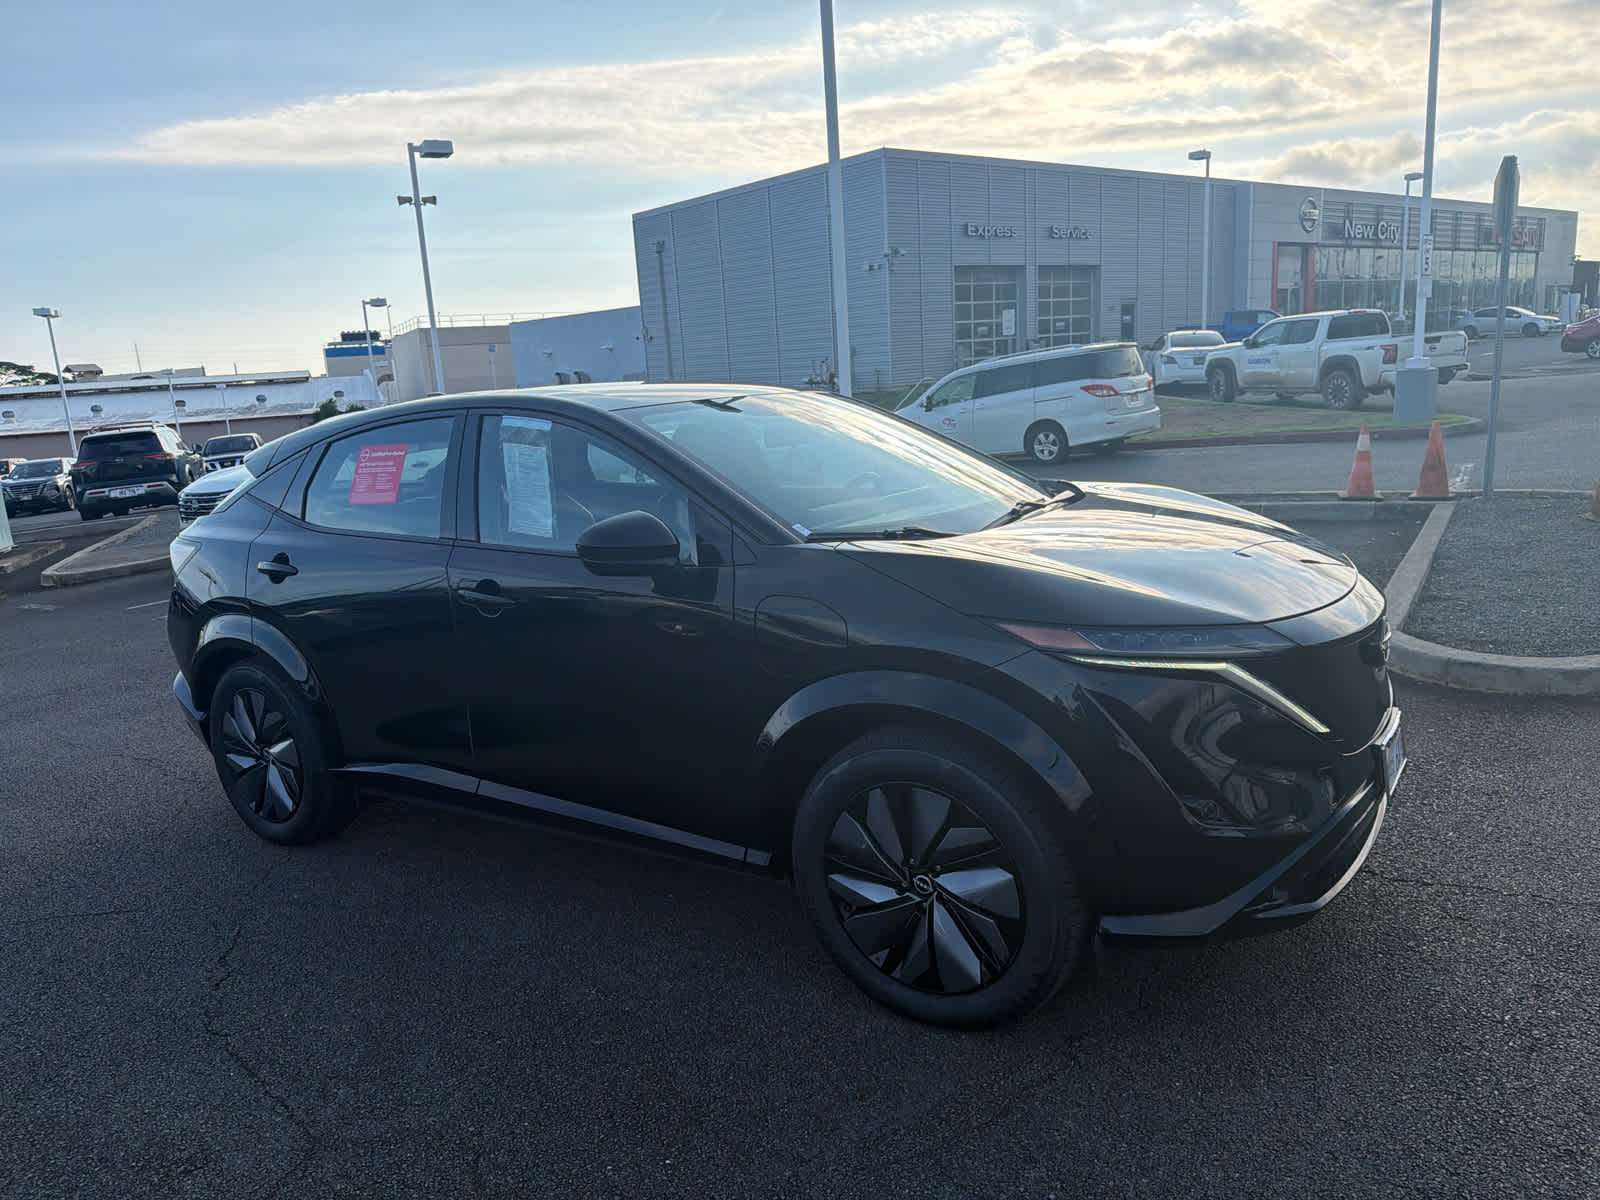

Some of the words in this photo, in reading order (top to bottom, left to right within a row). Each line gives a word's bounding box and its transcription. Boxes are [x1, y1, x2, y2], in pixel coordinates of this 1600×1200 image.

[966, 222, 1017, 239] Express
[1050, 224, 1094, 239] Service
[1344, 219, 1375, 239] New
[1377, 221, 1401, 244] City
